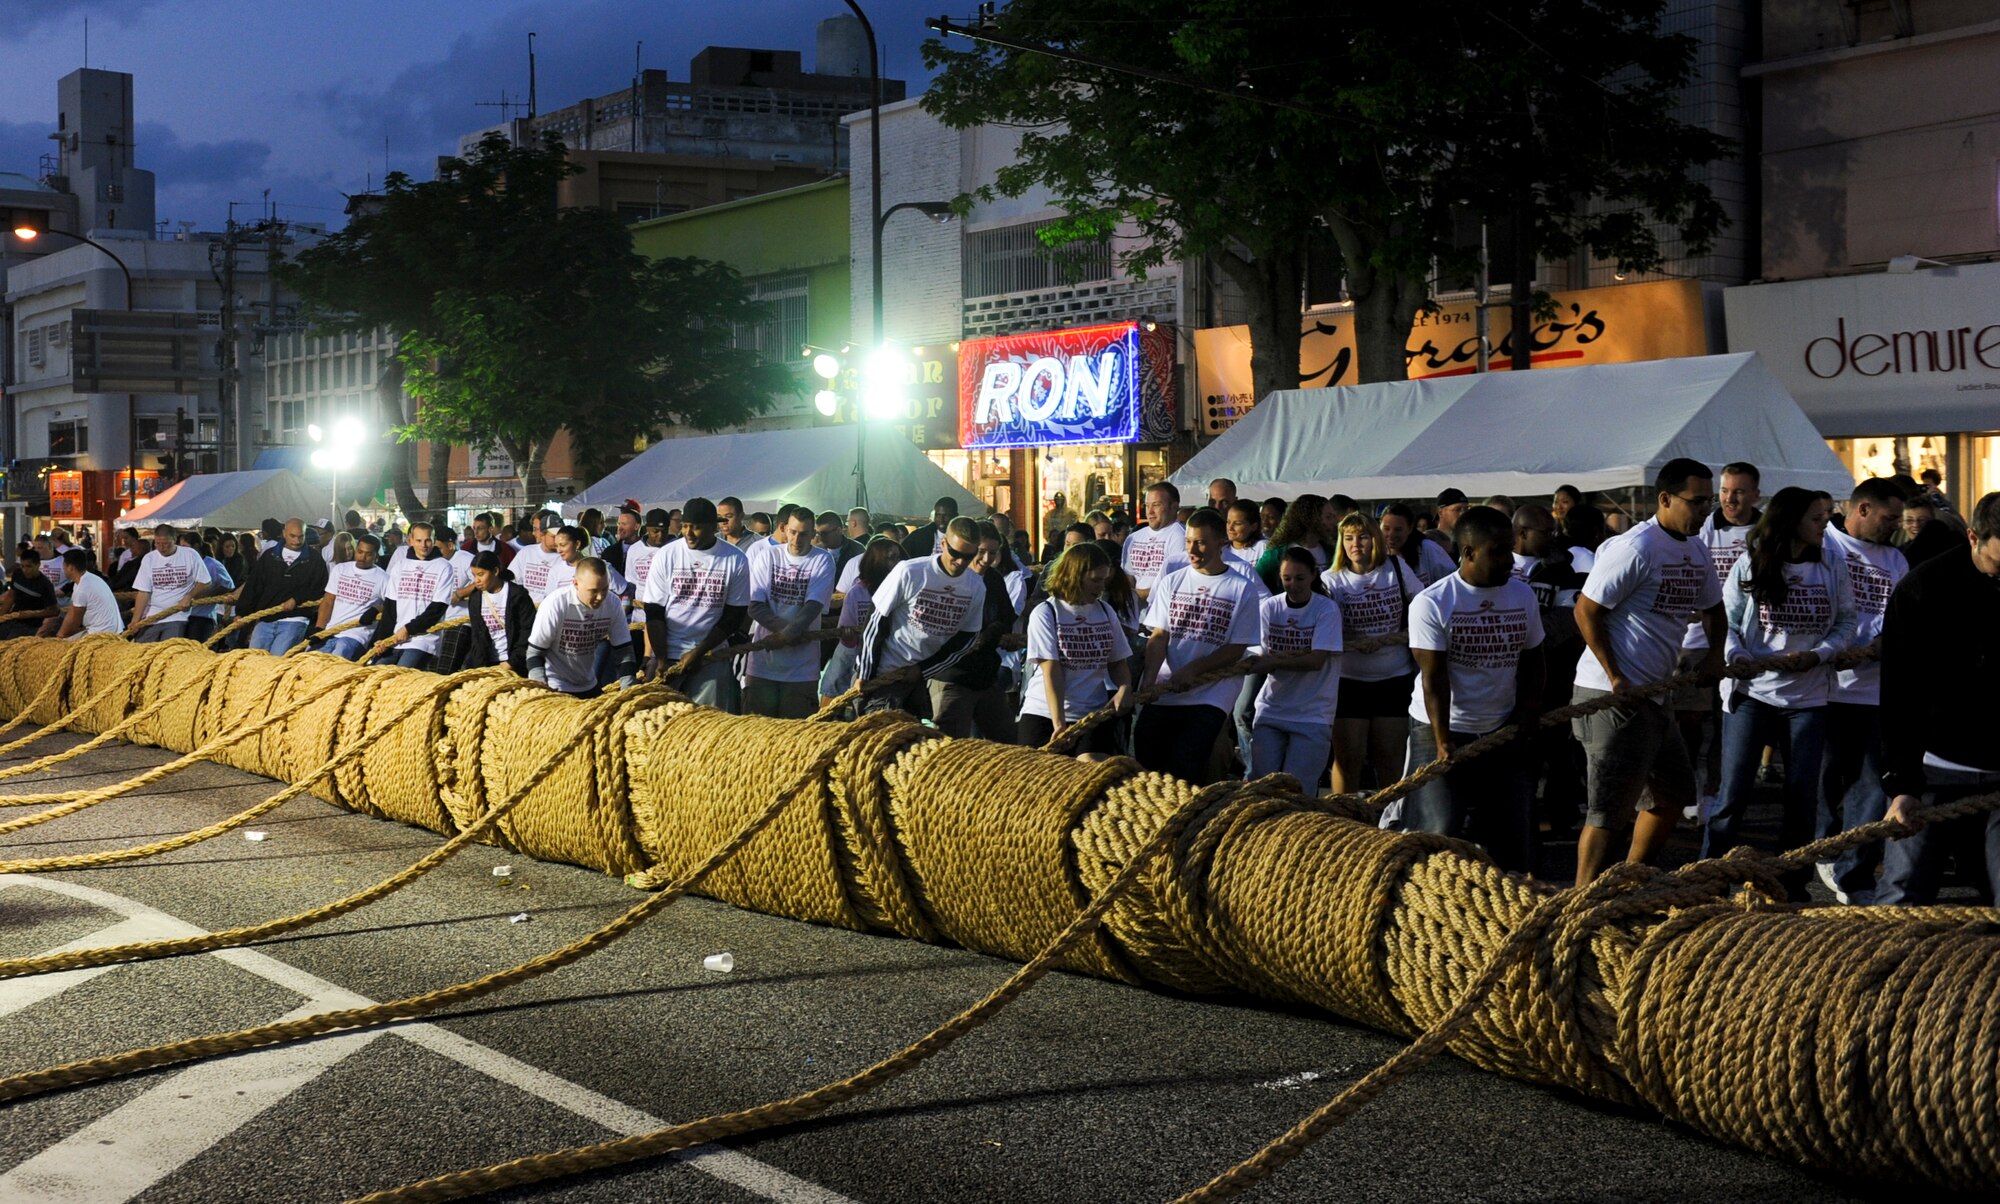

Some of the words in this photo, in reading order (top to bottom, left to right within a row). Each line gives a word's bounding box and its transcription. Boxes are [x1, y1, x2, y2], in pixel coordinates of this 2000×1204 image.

[1434, 312, 1470, 326] 1974
[1804, 317, 2000, 379] demure
[975, 351, 1116, 424] RON
[1868, 585, 1892, 596] 2012
[1195, 597, 1210, 606] THE
[1365, 592, 1381, 601] THE
[1342, 596, 1400, 610] INTERNATIONA
[1170, 602, 1232, 619] INTERNATIONAL
[1344, 606, 1386, 617] CARNIVAL
[1210, 616, 1230, 627] 2012
[1353, 614, 1390, 624] OKINAWA
[1481, 615, 1501, 624] THE
[1770, 614, 1814, 622] OKINAWA
[1210, 624, 1229, 634] CITY
[1452, 623, 1527, 635] INTERNATIONAL
[1452, 634, 1504, 644] CARNIVAL
[1451, 643, 1462, 651] IN
[1464, 644, 1507, 654] OKINAWA
